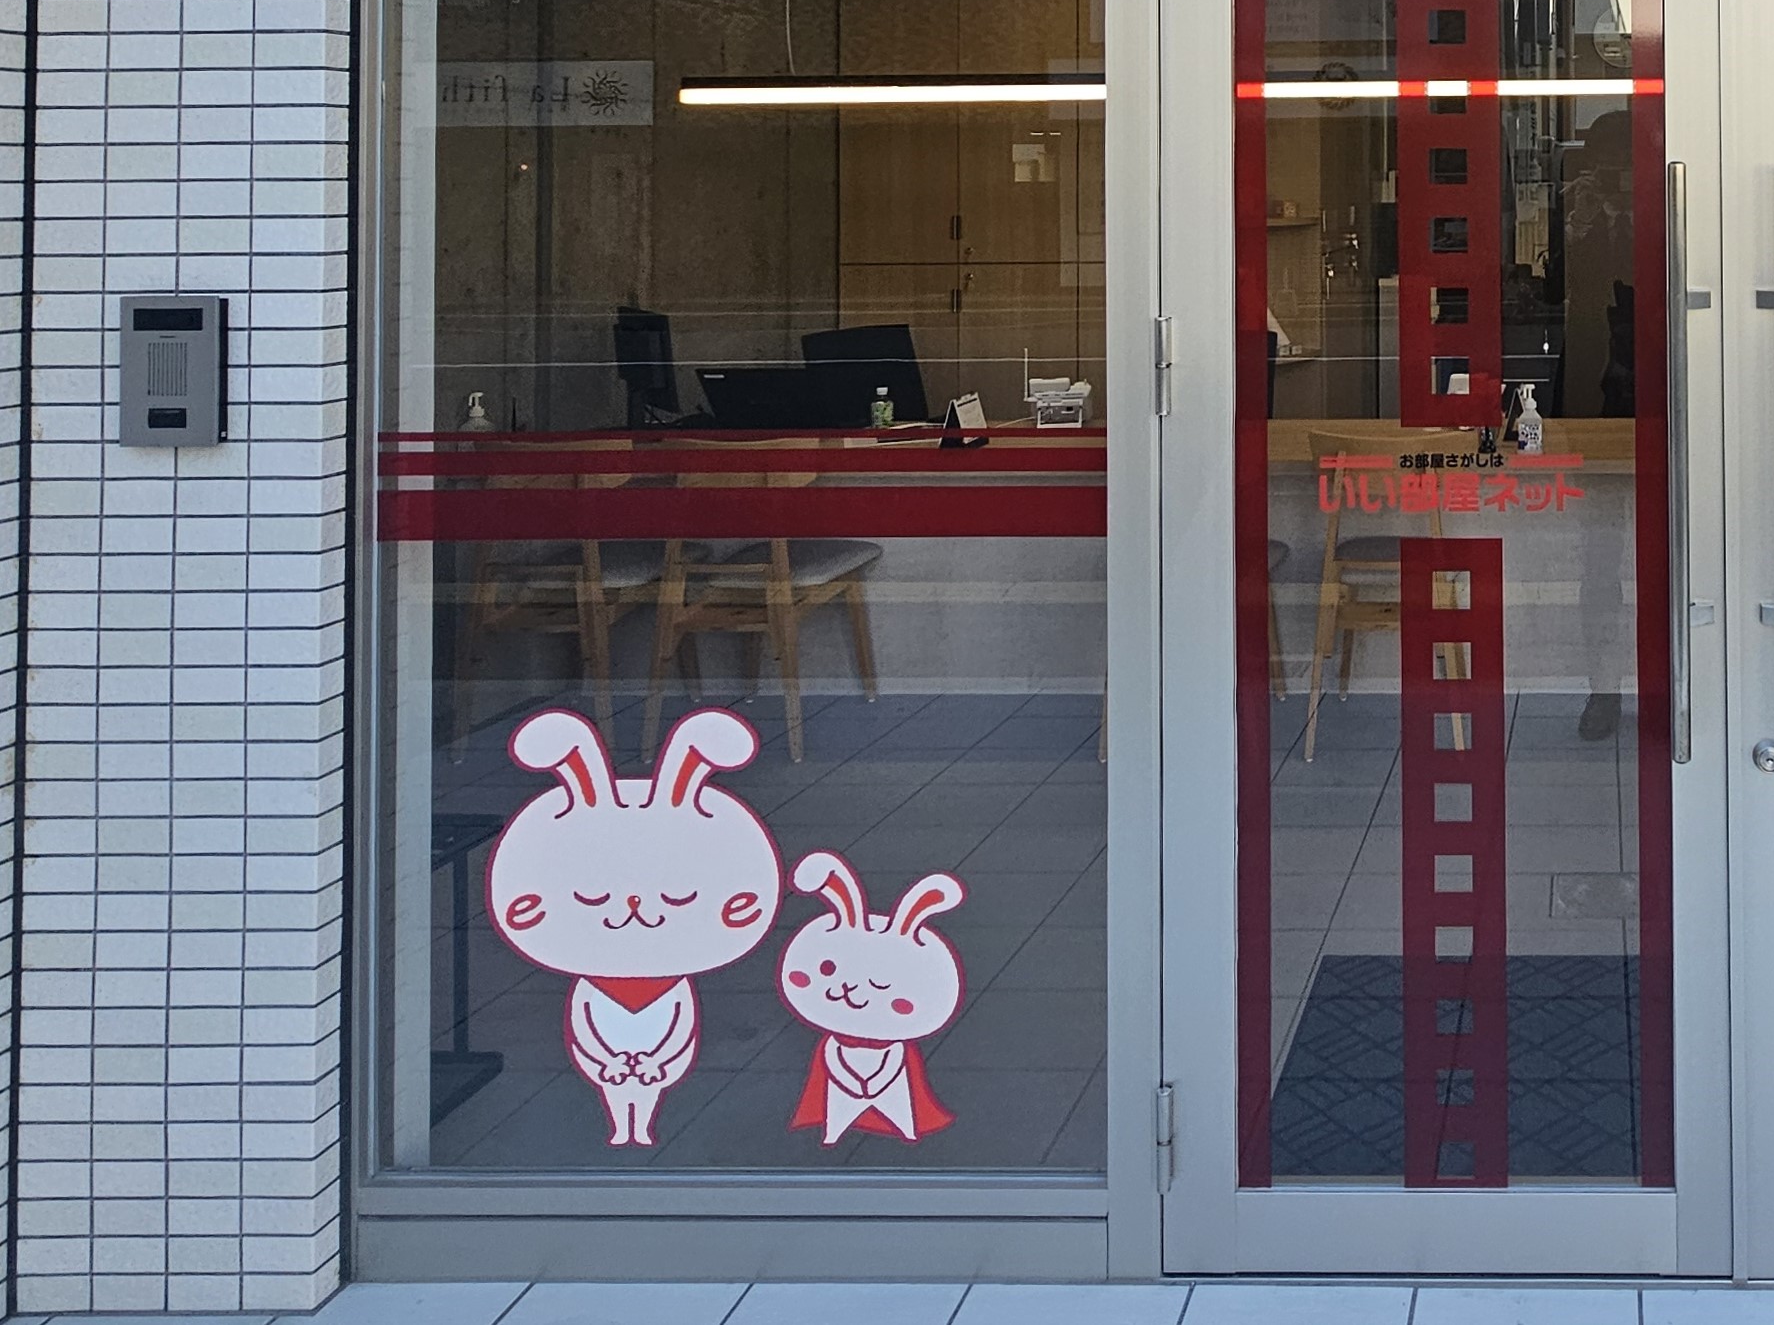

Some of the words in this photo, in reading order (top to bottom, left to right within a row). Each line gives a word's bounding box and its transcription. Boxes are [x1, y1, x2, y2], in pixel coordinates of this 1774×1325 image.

[1399, 453, 1505, 469] お部屋さがしは
[1318, 472, 1585, 513] いい部屋ネット
